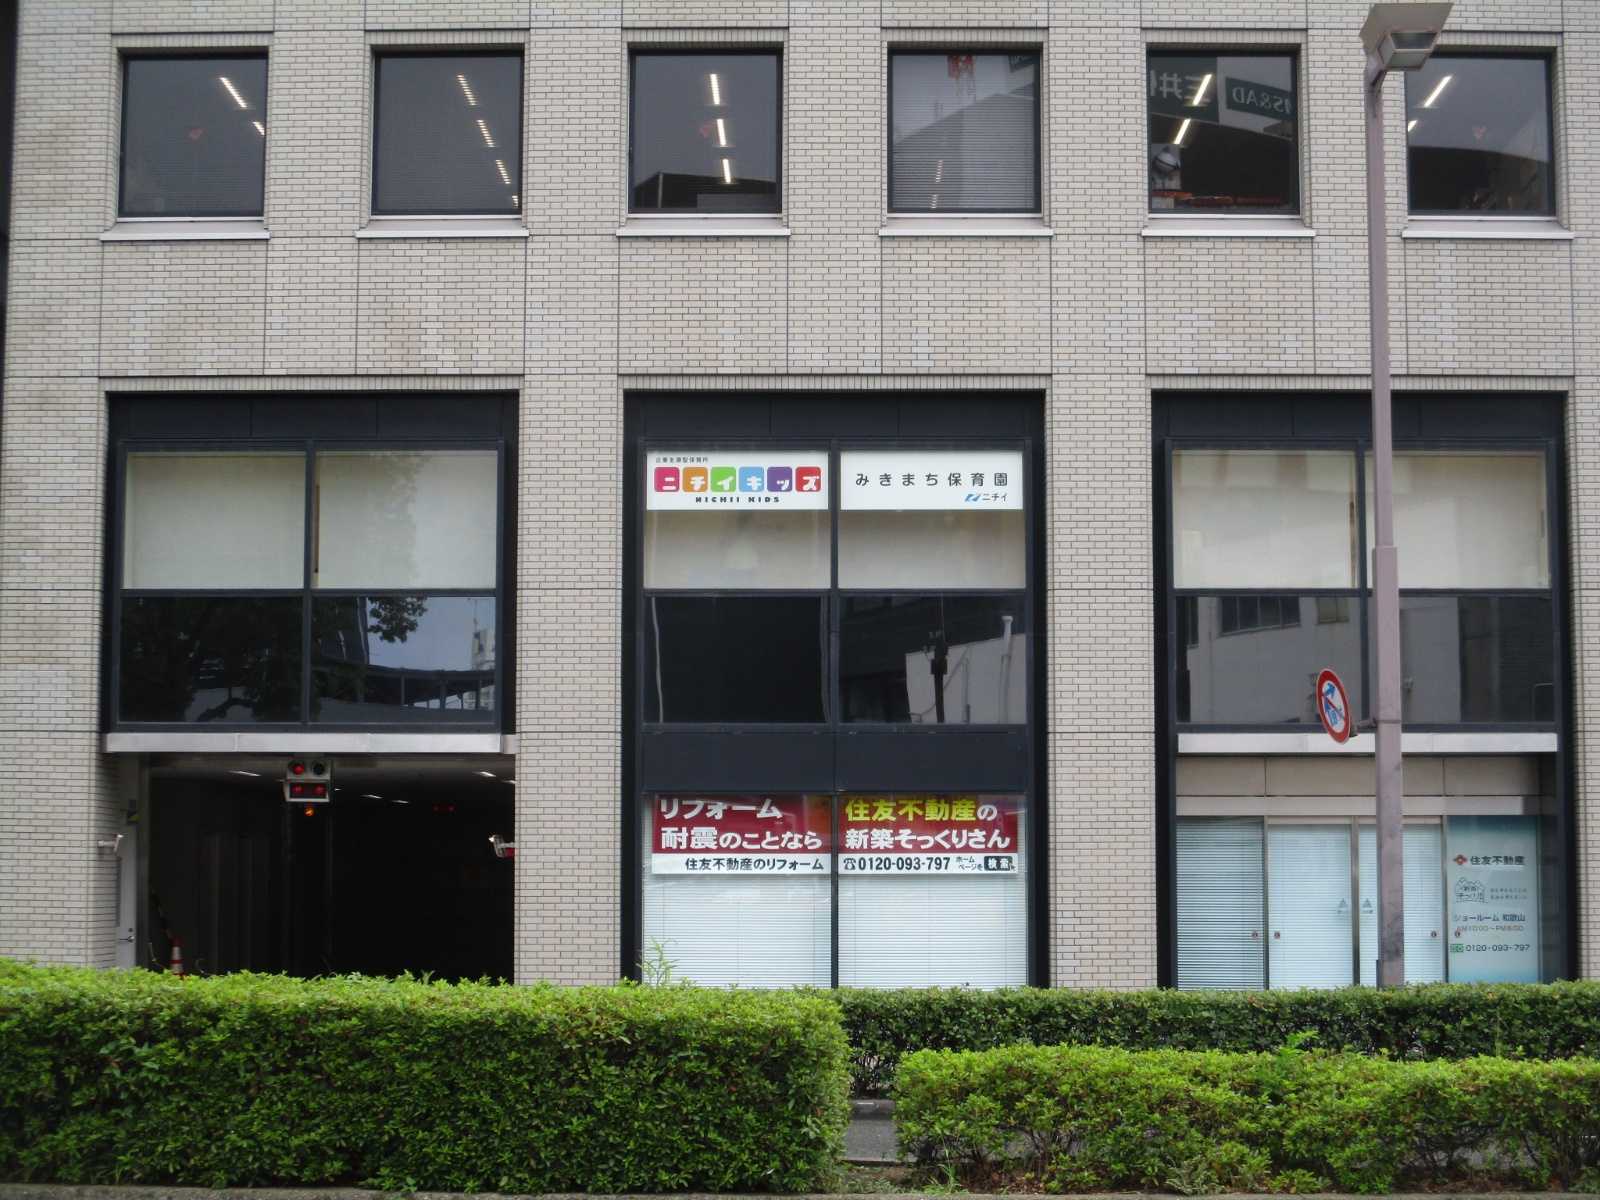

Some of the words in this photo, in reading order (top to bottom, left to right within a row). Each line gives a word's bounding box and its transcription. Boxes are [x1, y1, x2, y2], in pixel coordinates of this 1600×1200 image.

[658, 473, 821, 492] ニチイキッズ
[856, 472, 1008, 487] みきまち保育園
[982, 493, 1008, 502] ニチイ
[660, 798, 783, 820] リフォーム
[845, 799, 998, 822] 住友不動産の
[661, 826, 823, 850] 耐震のことなら
[845, 829, 1011, 850] 新築そっくりさん
[685, 857, 824, 871] 住友不動産のリフォーム
[858, 856, 951, 871] 0120-093-797
[1470, 855, 1526, 866] 住友不動産
